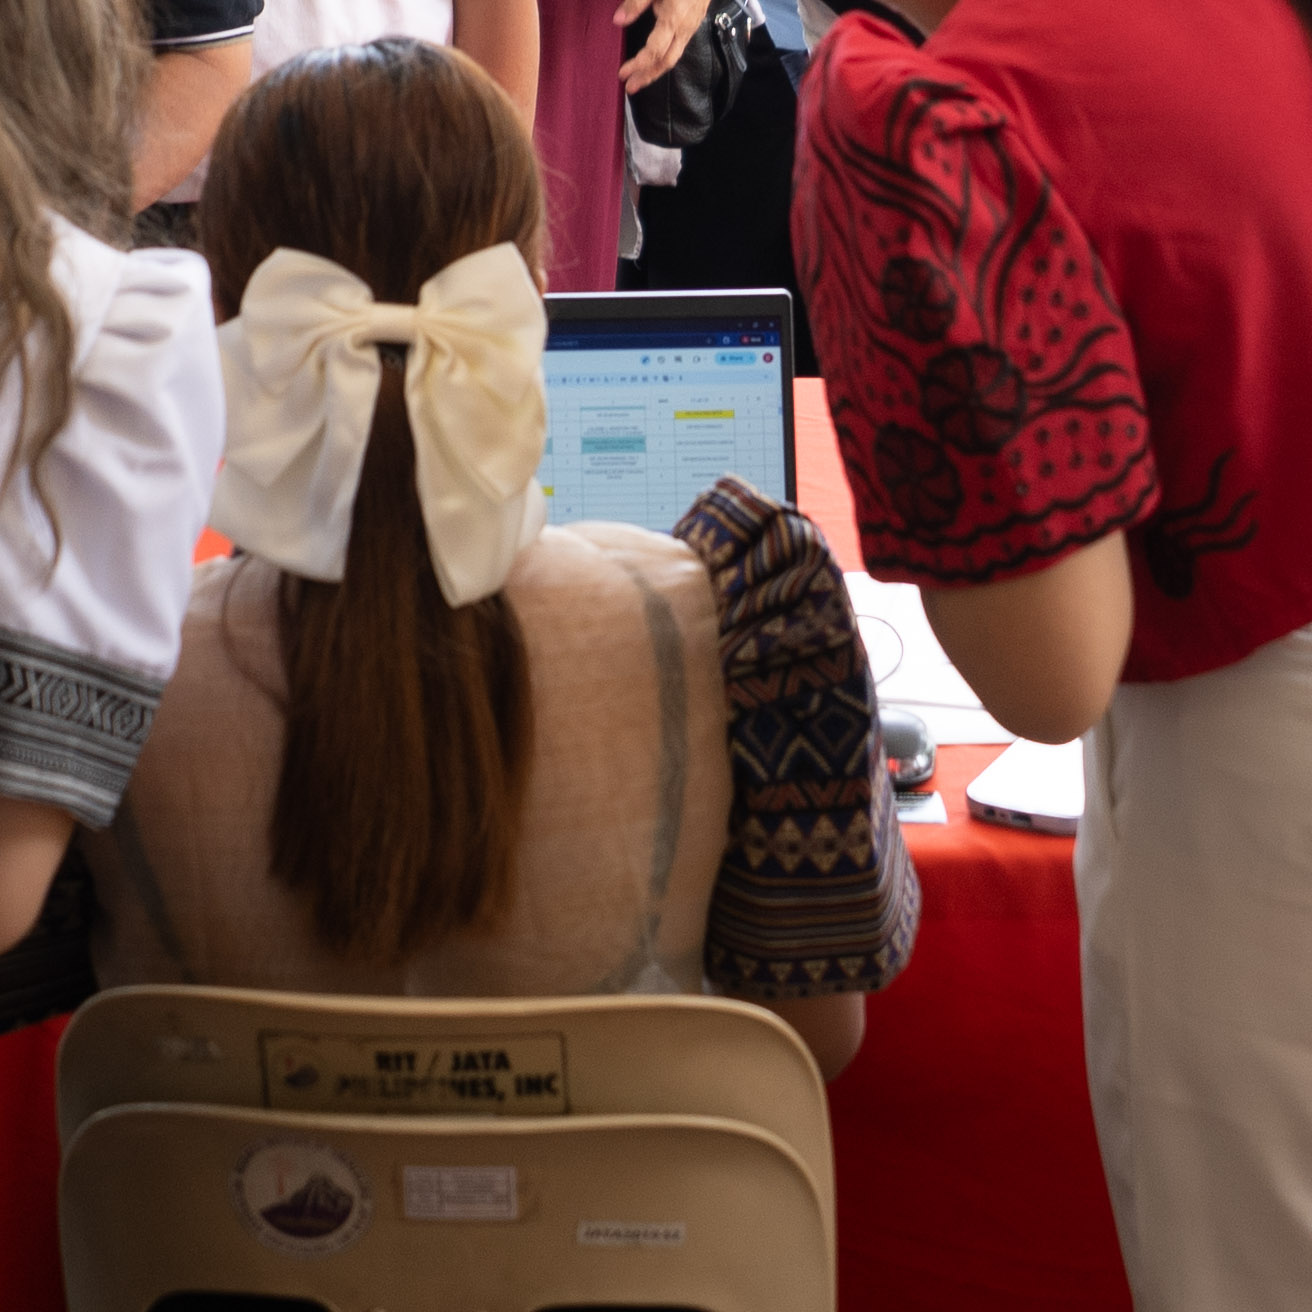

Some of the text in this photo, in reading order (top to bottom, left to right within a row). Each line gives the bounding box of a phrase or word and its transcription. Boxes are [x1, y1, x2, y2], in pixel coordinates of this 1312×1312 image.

[375, 1051, 416, 1072] RIT
[451, 1049, 511, 1072] JATA
[514, 1073, 557, 1097] INC
